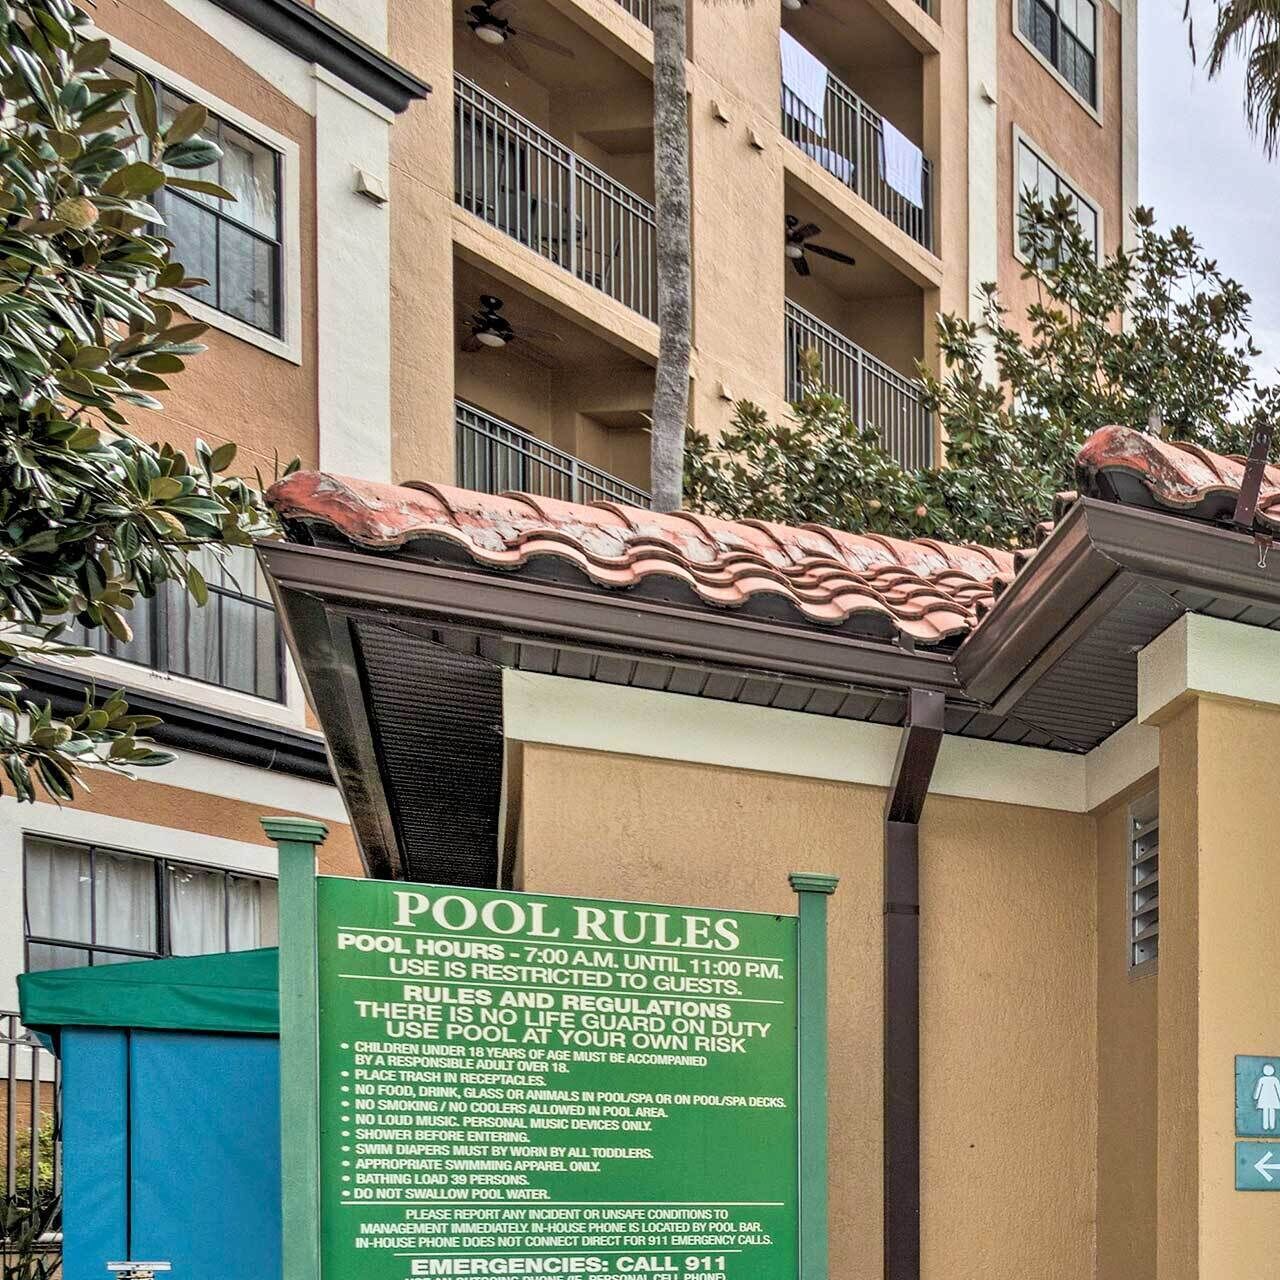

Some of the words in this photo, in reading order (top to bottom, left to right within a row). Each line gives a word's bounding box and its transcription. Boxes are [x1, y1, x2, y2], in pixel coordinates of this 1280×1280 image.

[393, 892, 560, 938] POOL
[573, 905, 739, 951] RULES
[338, 934, 410, 954] POOL
[416, 939, 505, 961] HOURS
[524, 945, 568, 965] 7:00
[572, 948, 618, 968] A.M.
[624, 952, 686, 973] UNTIL
[690, 956, 741, 977] 11:00
[744, 959, 783, 979] P.M.
[390, 960, 439, 977] USE
[445, 963, 467, 979] IS
[473, 964, 612, 988] RESTRICTED
[616, 972, 651, 990] TO
[654, 974, 742, 995] GUESTS.
[404, 985, 492, 1006] RULES
[500, 990, 554, 1009] AND
[562, 993, 732, 1019] REGULATIONS
[355, 1001, 442, 1022] THERE
[450, 1006, 473, 1023] IS
[481, 1007, 518, 1026] NO
[525, 1010, 575, 1028] LIFE
[582, 1013, 665, 1033] GUARD
[672, 1017, 705, 1035] ON
[712, 1019, 770, 1038] DUTY
[387, 1021, 439, 1039] USE
[447, 1024, 516, 1043] POOL
[522, 1027, 552, 1044] AT
[558, 1029, 625, 1048] YOUR
[632, 1032, 687, 1050] OWN
[695, 1035, 745, 1053] RISK
[355, 1042, 419, 1055] CHILDREN
[422, 1045, 465, 1057] UNDER
[469, 1047, 484, 1057] 18
[487, 1047, 526, 1059] YEARS
[529, 1049, 545, 1060] OF
[547, 1050, 570, 1061] AGE
[573, 1051, 607, 1062] MUST
[610, 1053, 625, 1063] BE
[627, 1053, 707, 1066] ACCOMPANIED
[355, 1055, 373, 1066] BY
[375, 1056, 384, 1066] A
[388, 1056, 474, 1069] RESPONSIBLE
[476, 1059, 514, 1071] ADULT
[517, 1061, 548, 1072] OVER
[553, 1062, 568, 1073] 18.
[355, 1069, 396, 1081] PLACE
[399, 1071, 441, 1083] TRASH
[444, 1073, 457, 1083] IN
[460, 1073, 546, 1086] RECEPTACLES.
[355, 1084, 375, 1096] NO
[378, 1085, 416, 1097] FOOD,
[419, 1086, 460, 1098] DRINK,
[464, 1088, 504, 1099] GLASS
[506, 1089, 524, 1100] OR
[526, 1090, 579, 1102] ANIMALS
[582, 1092, 594, 1102] IN
[597, 1092, 653, 1104] POOL/SPA
[655, 1094, 672, 1104] OR
[674, 1094, 690, 1105] ON
[693, 1095, 747, 1106] POOL/SPA
[749, 1097, 786, 1107] DECKS.
[355, 1100, 375, 1110] NO
[378, 1100, 438, 1112] SMOKING
[449, 1102, 467, 1112] NO
[470, 1103, 526, 1114] COOLERS
[529, 1104, 585, 1115] ALLOWED
[588, 1106, 600, 1116] IN
[603, 1106, 632, 1116] POOL
[635, 1107, 668, 1117] AREA.
[356, 1114, 375, 1125] NO
[378, 1115, 413, 1126] LOUD
[416, 1116, 459, 1127] MUSIC.
[463, 1117, 527, 1128] PERSONAL
[530, 1118, 568, 1129] MUSIC
[571, 1119, 619, 1130] DEVICES
[622, 1121, 651, 1130] ONLY.
[356, 1130, 412, 1140] SHOWER
[415, 1131, 464, 1141] BEFORE
[467, 1131, 530, 1142] ENTERING.
[356, 1144, 393, 1155] SWIM
[396, 1145, 450, 1155] DIAPERS
[453, 1146, 489, 1156] MUST
[492, 1146, 509, 1156] BY
[510, 1146, 547, 1157] WORN
[550, 1147, 566, 1157] BY
[568, 1147, 589, 1157] ALL
[592, 1148, 653, 1158] TODDLERS.
[356, 1159, 442, 1170] APPROPRIATE
[445, 1160, 512, 1170] SWIMMING
[514, 1161, 567, 1171] APPAREL
[570, 1162, 600, 1171] ONLY.
[356, 1174, 412, 1184] BATHING
[414, 1175, 448, 1184] LOAD
[451, 1175, 467, 1184] 39
[470, 1175, 528, 1184] PERSONS.
[354, 1189, 373, 1199] DO
[376, 1189, 402, 1199] NOT
[405, 1189, 468, 1199] SWALLOW
[472, 1189, 504, 1199] POOL
[507, 1189, 550, 1199] WATER.
[361, 1223, 448, 1234] MANAGEMENT
[451, 1223, 528, 1233] IMMEDIATELY.
[532, 1223, 586, 1233] IN-HOUSE
[589, 1223, 626, 1233] PHONE
[629, 1223, 639, 1233] IS
[642, 1223, 690, 1233] LOCATED
[693, 1223, 708, 1232] BY
[709, 1223, 736, 1232] POOL
[740, 1223, 763, 1232] BAR.
[356, 1237, 416, 1248] IN-HOUSE
[419, 1237, 459, 1247] PHONE
[463, 1237, 495, 1247] DOES
[498, 1237, 520, 1247] NOT
[525, 1236, 579, 1247] CONNECT
[582, 1236, 621, 1246] DIRECT
[624, 1236, 645, 1246] FOR
[648, 1236, 667, 1246] 911
[672, 1236, 735, 1245] EMERGENCY
[738, 1236, 772, 1245] CALLS.
[412, 1258, 608, 1275] EMERGENCIES:
[617, 1257, 678, 1272] CALL
[686, 1257, 724, 1271] 911
